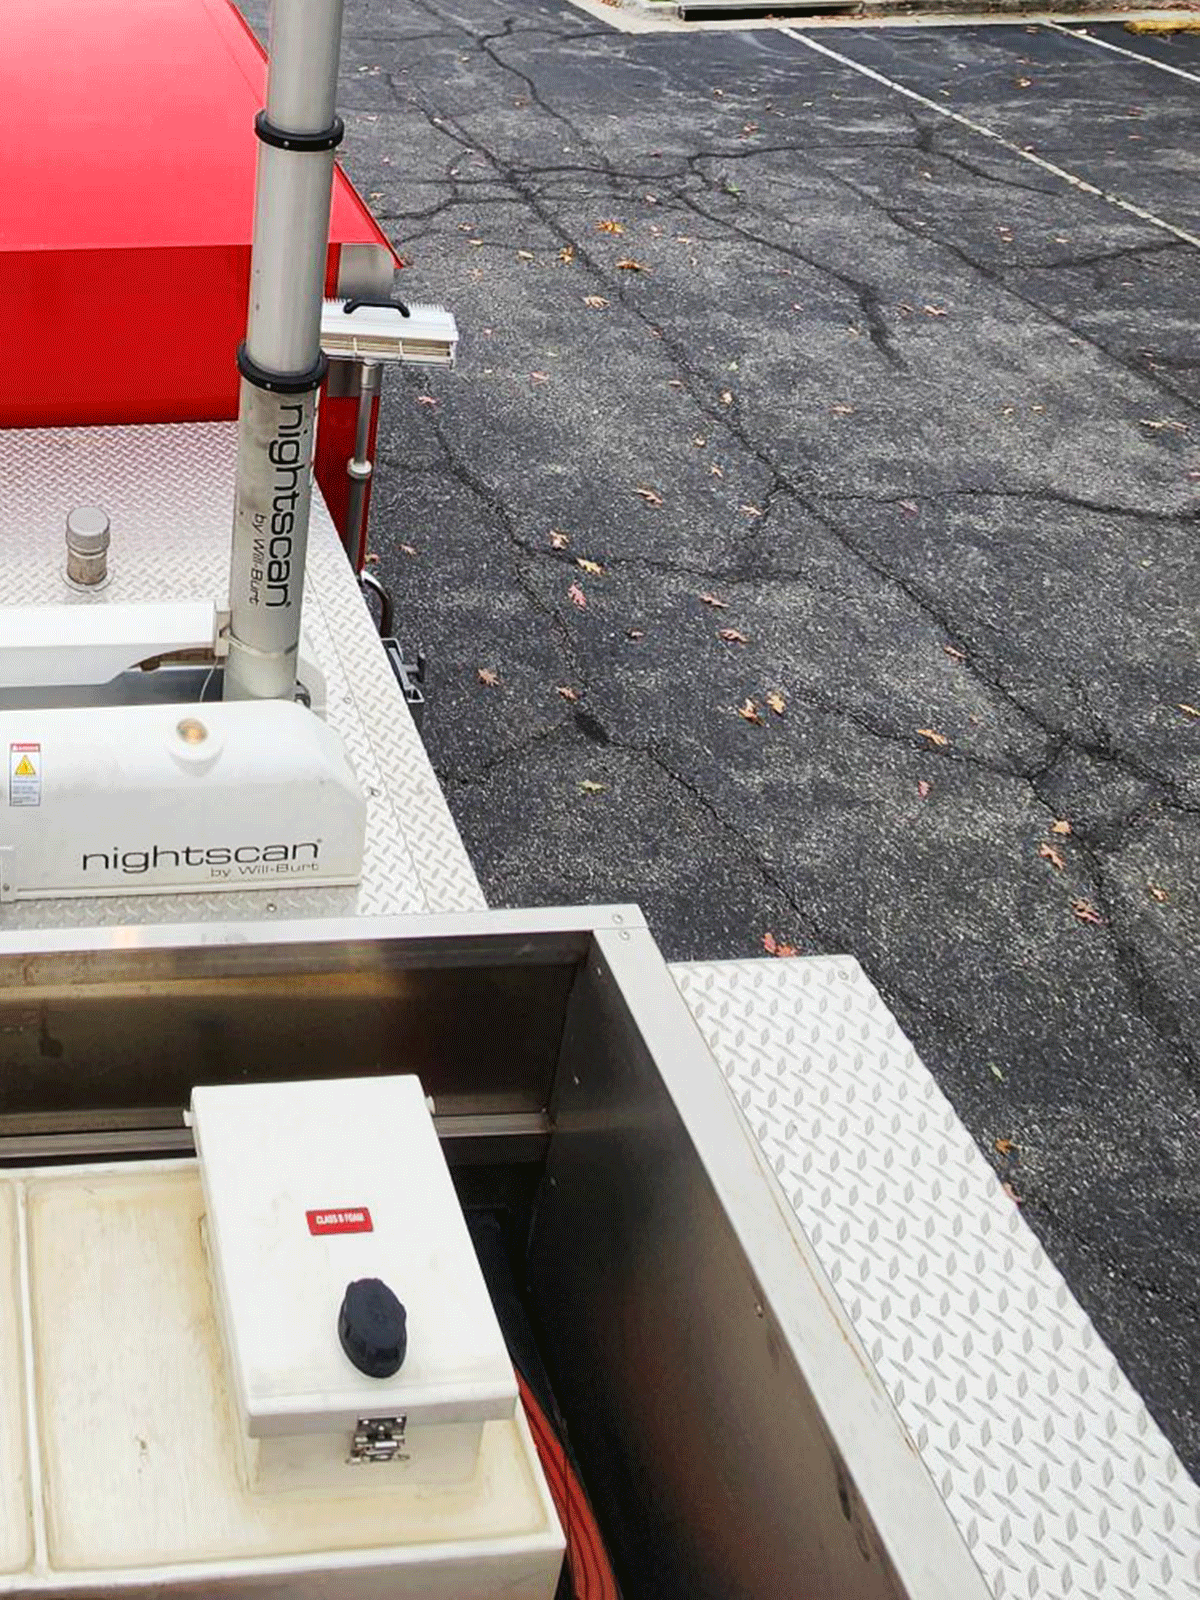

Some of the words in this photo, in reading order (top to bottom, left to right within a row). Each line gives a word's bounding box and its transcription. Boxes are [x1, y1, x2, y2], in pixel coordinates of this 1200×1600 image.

[266, 404, 308, 607] nightscan
[252, 513, 266, 534] by
[249, 538, 265, 606] Will-Burt
[82, 842, 319, 875] nightscan
[210, 867, 232, 878] by
[315, 1214, 338, 1225] CLASS
[345, 1212, 365, 1223] FOAM
